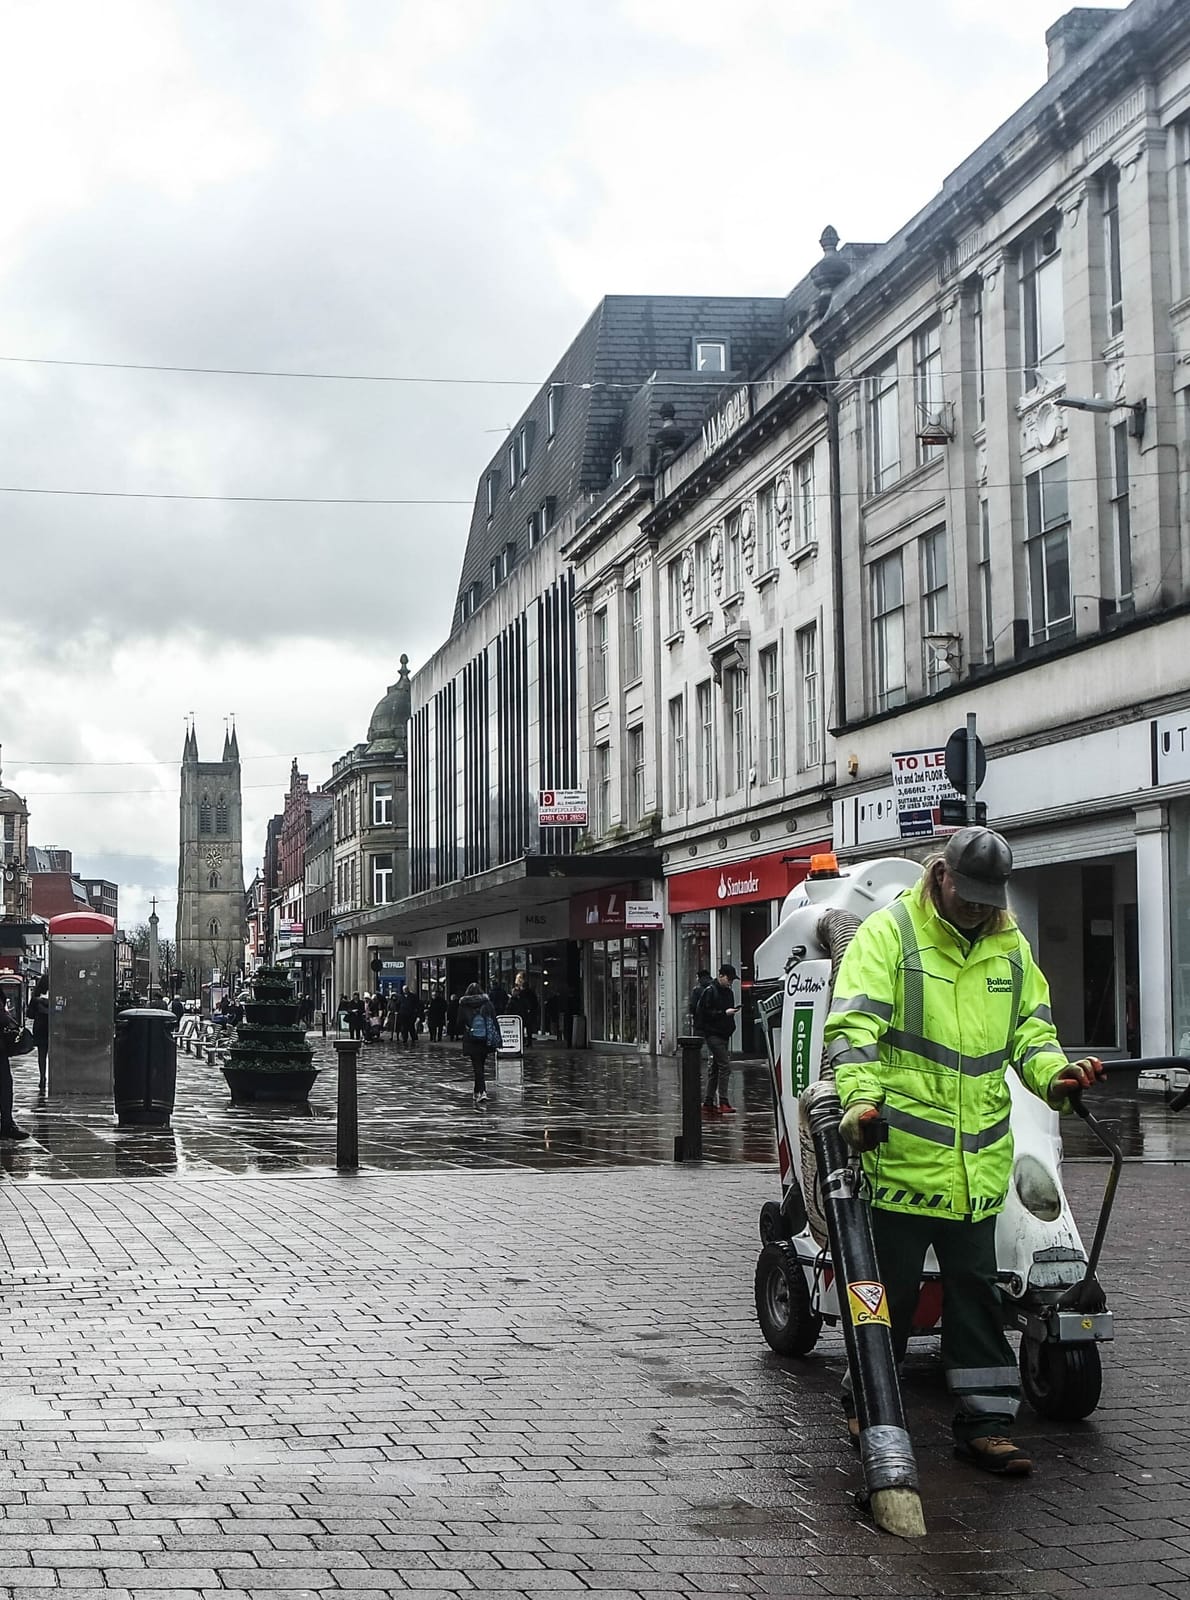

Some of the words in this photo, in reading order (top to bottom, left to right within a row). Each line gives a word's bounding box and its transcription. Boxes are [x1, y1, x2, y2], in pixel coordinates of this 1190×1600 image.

[895, 757, 918, 771] TO
[924, 754, 945, 767] LE
[894, 775, 903, 786] 1st
[904, 773, 914, 784] and
[915, 771, 925, 783] 2nd
[925, 769, 944, 782] FLOOR
[932, 783, 952, 793] 7,295
[897, 796, 923, 805] SUITABLE
[924, 794, 934, 802] FOR
[922, 800, 939, 808] SUBJE
[727, 871, 760, 897] Santander
[525, 915, 547, 925] M&S
[382, 961, 405, 969] ETFRED
[787, 972, 822, 997] Glutton
[986, 977, 1012, 986] Bolton
